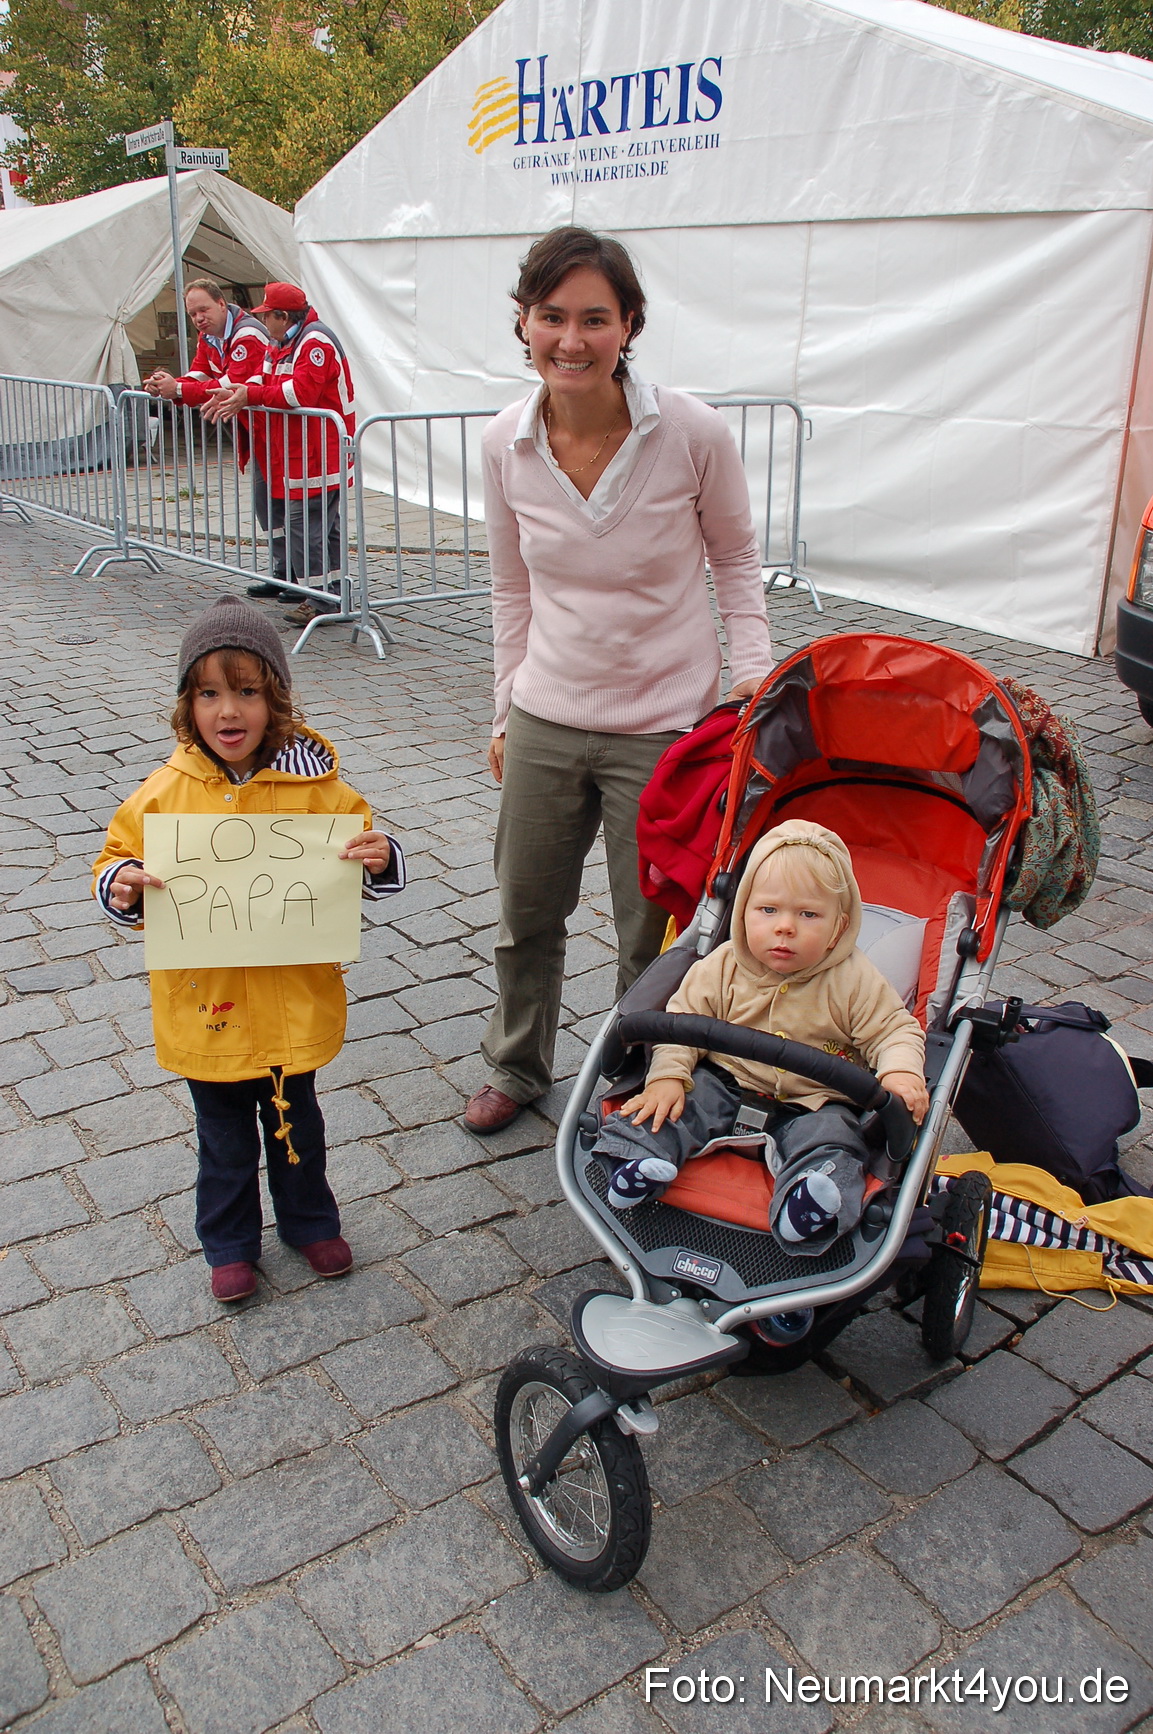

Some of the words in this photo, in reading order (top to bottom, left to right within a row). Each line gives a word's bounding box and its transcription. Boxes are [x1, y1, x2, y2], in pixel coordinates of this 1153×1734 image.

[514, 54, 723, 145] HÄRTEIS
[128, 137, 140, 150] Untere
[140, 128, 165, 147] Marktstraße
[513, 151, 570, 170] GETRÄNKE
[579, 145, 618, 162] WEINE
[627, 133, 720, 158] ZELTVERLEIH
[180, 151, 225, 167] Rainbügl
[551, 160, 669, 186] WWW.HAERTEIS.DE
[164, 873, 318, 940] PAPA
[677, 1257, 716, 1280] chicco
